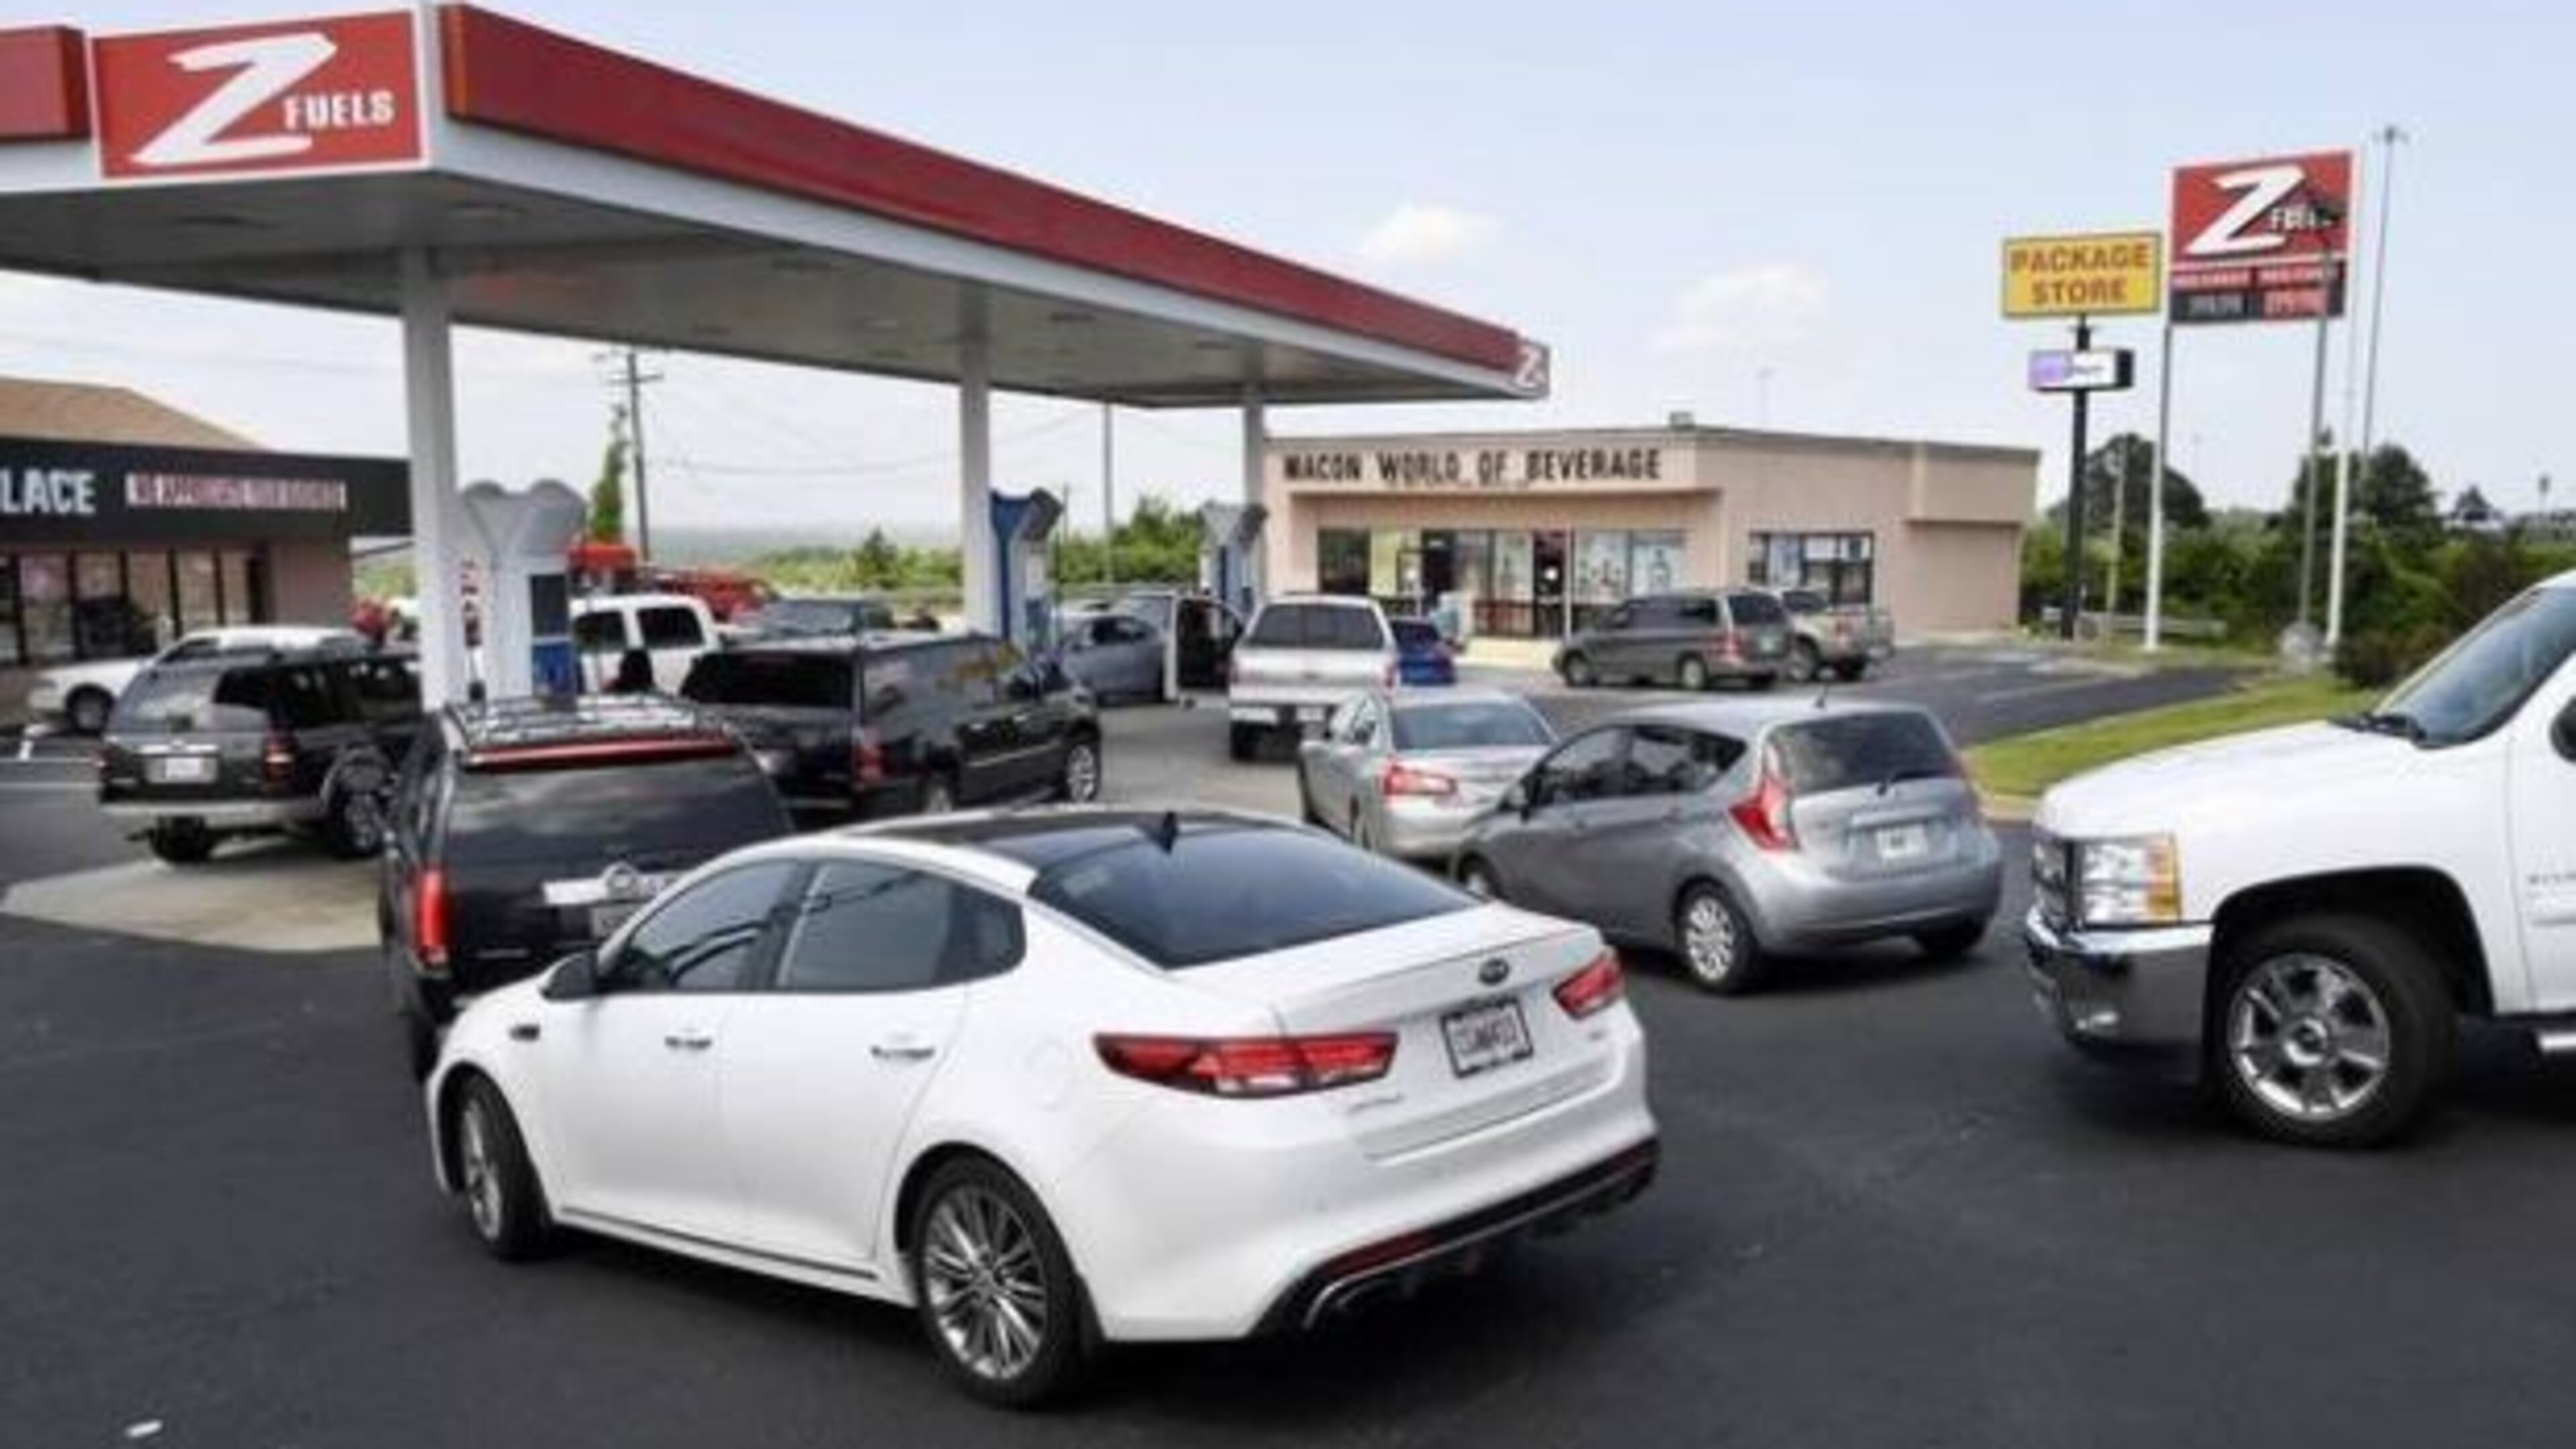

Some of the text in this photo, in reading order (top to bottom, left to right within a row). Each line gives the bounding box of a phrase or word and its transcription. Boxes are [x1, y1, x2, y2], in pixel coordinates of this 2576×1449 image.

[129, 32, 394, 165] Z FUELS
[2185, 166, 2306, 255] Z
[2010, 244, 2149, 273] PACKAGE
[2031, 277, 2128, 305] STORE
[1284, 448, 1661, 485] MACON WORLD OF BEVERAGE
[0, 469, 96, 514] LACE
